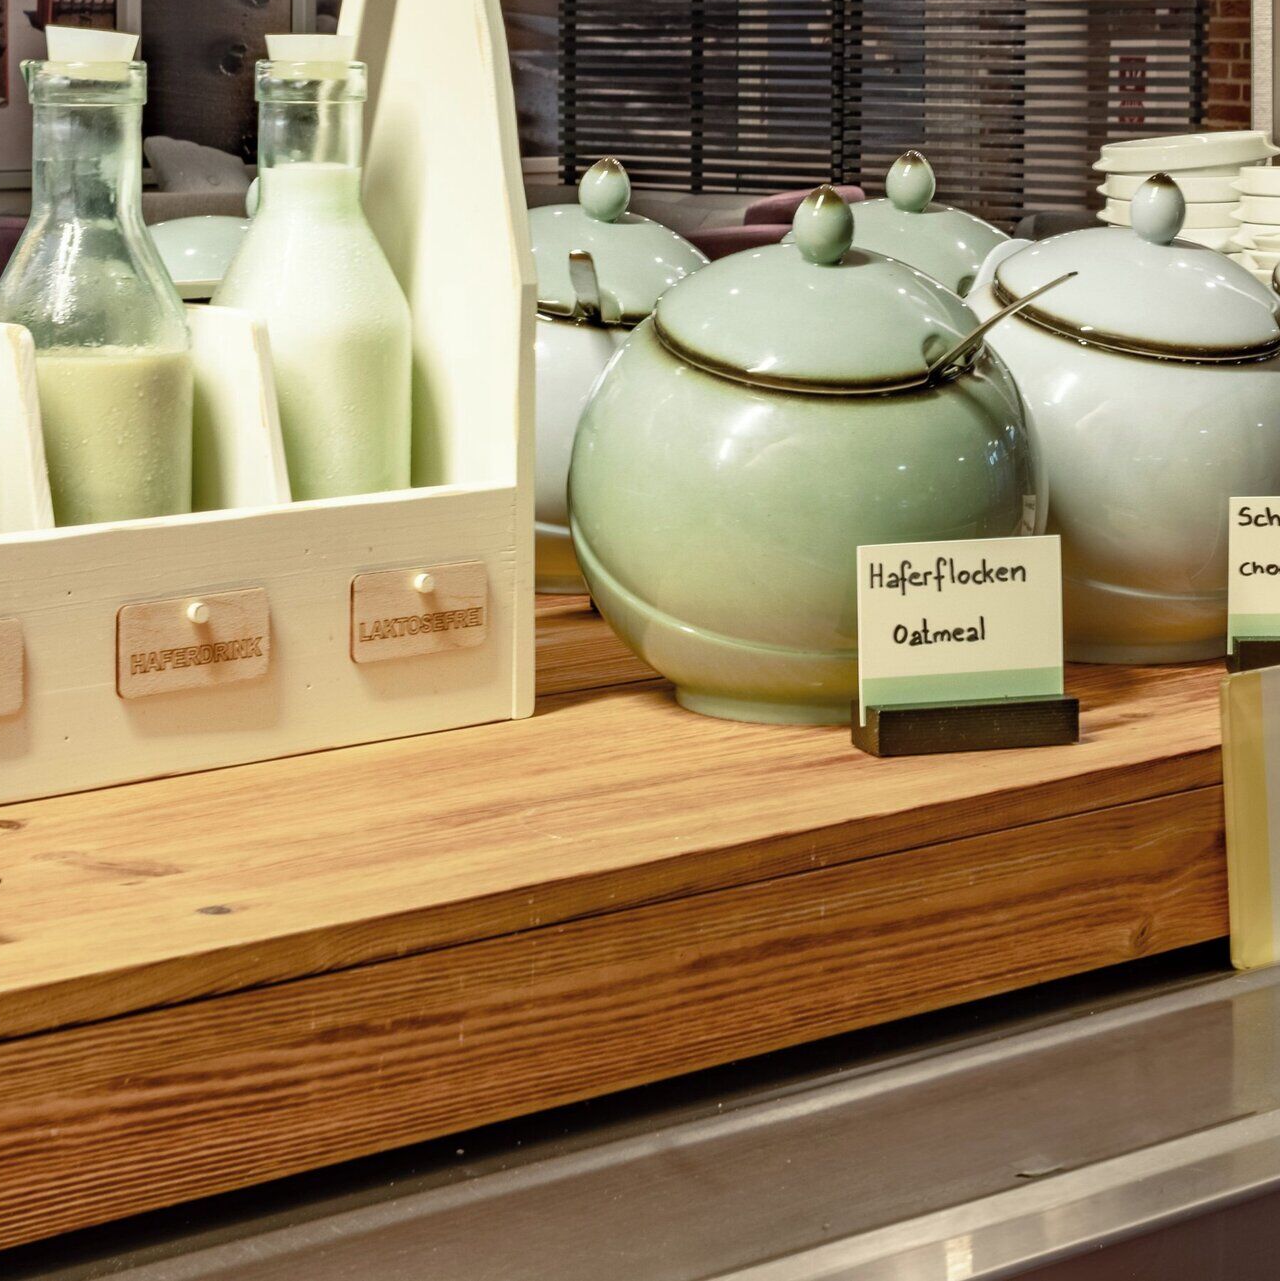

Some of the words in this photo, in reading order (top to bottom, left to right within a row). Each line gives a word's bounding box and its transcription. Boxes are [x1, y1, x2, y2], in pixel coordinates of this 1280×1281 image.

[869, 556, 1027, 596] Haferflocken
[892, 616, 986, 647] Oatmeal
[130, 636, 263, 675] HAFERDRINK
